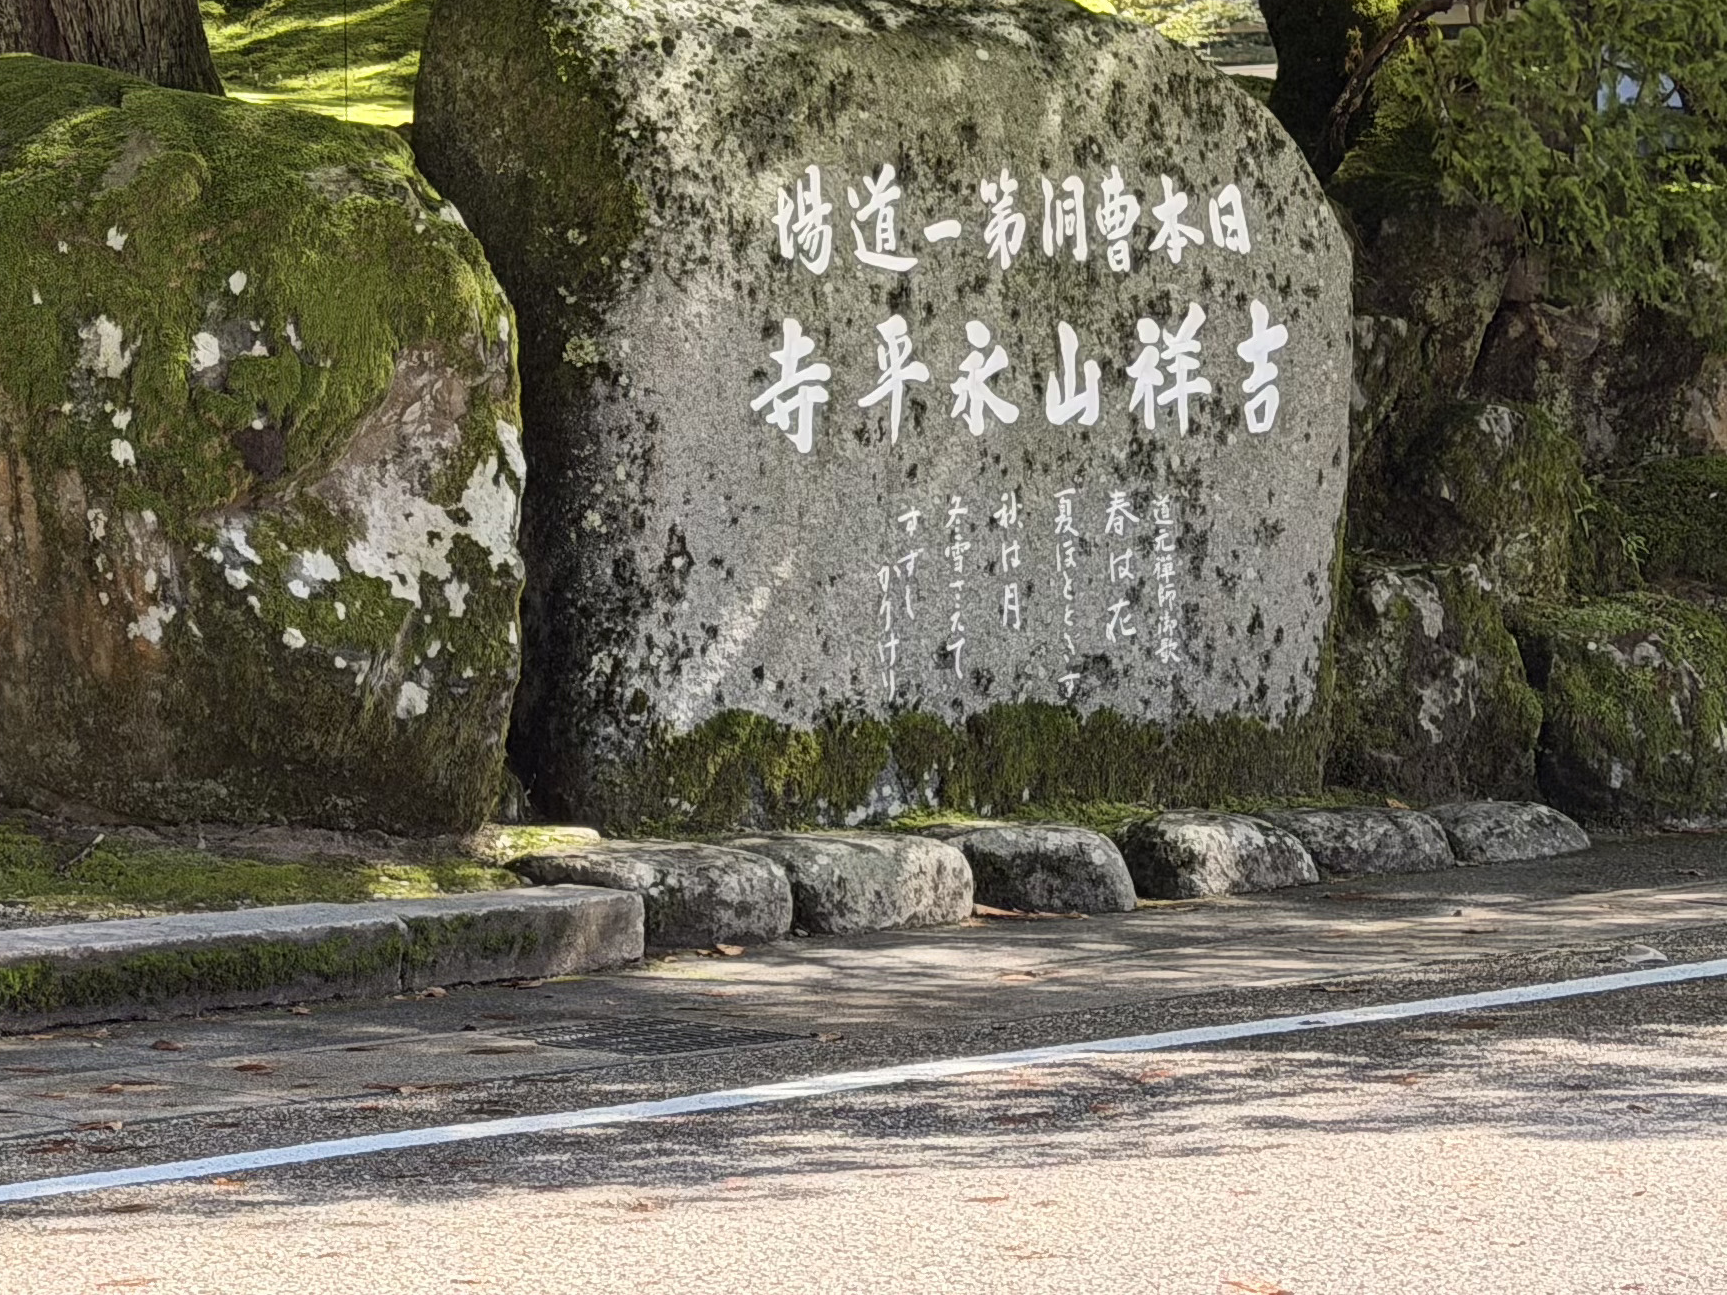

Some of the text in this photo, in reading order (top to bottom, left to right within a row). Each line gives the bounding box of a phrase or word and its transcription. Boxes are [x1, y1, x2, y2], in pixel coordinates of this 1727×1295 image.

[772, 164, 1252, 275] 日本曹洞第一道場
[750, 299, 1288, 454] 吉祥山永平寺
[994, 491, 1023, 631] 秋は月
[1104, 489, 1140, 644] 春は花
